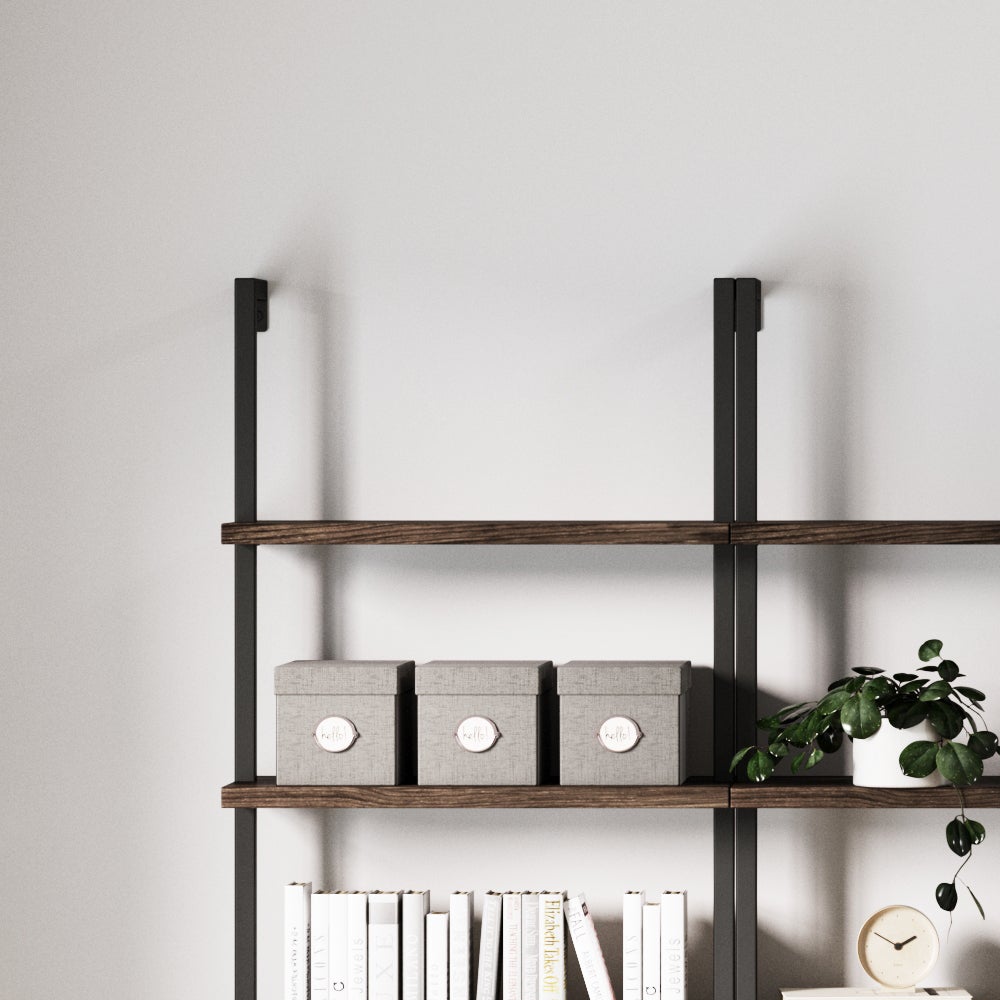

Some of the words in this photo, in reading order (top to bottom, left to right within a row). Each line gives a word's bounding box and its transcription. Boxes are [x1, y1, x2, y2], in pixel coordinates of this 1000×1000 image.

[321, 726, 347, 741] hello!
[462, 726, 488, 741] hello!
[604, 726, 631, 741] hello!
[543, 899, 561, 946] Elizabeth
[350, 936, 364, 994] Jewels
[543, 947, 561, 974] Takes
[664, 937, 681, 994] Jewels
[543, 975, 561, 994] Off
